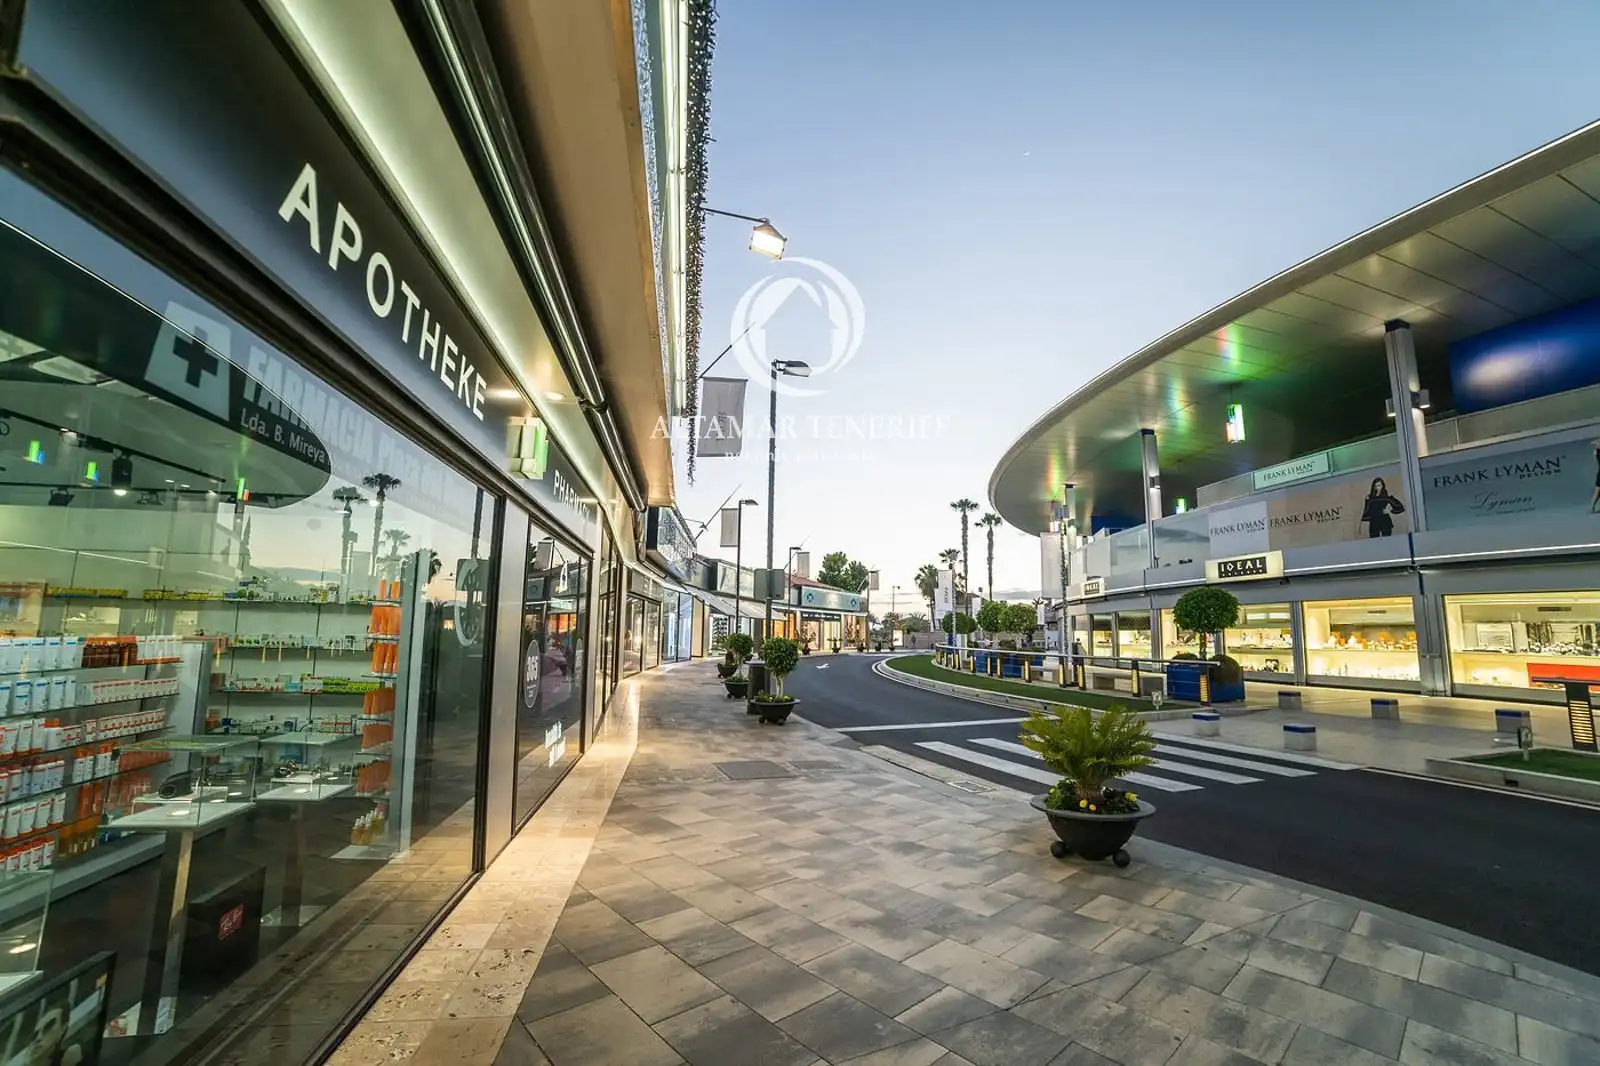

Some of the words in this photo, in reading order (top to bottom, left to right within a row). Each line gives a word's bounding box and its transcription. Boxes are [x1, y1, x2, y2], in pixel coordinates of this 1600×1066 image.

[278, 163, 487, 421] APOTHEKE
[243, 345, 373, 464] FARMACIA
[240, 409, 270, 437] Lda.
[274, 427, 285, 444] B.
[289, 434, 329, 463] Mireya
[1263, 470, 1287, 481] FRANK
[1288, 461, 1313, 475] LYMAN
[1434, 469, 1488, 488] FRANK
[1495, 457, 1560, 478] LYMAN
[1210, 525, 1235, 536] FRANK
[1237, 519, 1265, 531] LYMAN
[1269, 514, 1300, 527] FRANK
[1303, 507, 1340, 521] LYMAN
[1221, 559, 1263, 572] IDEAL
